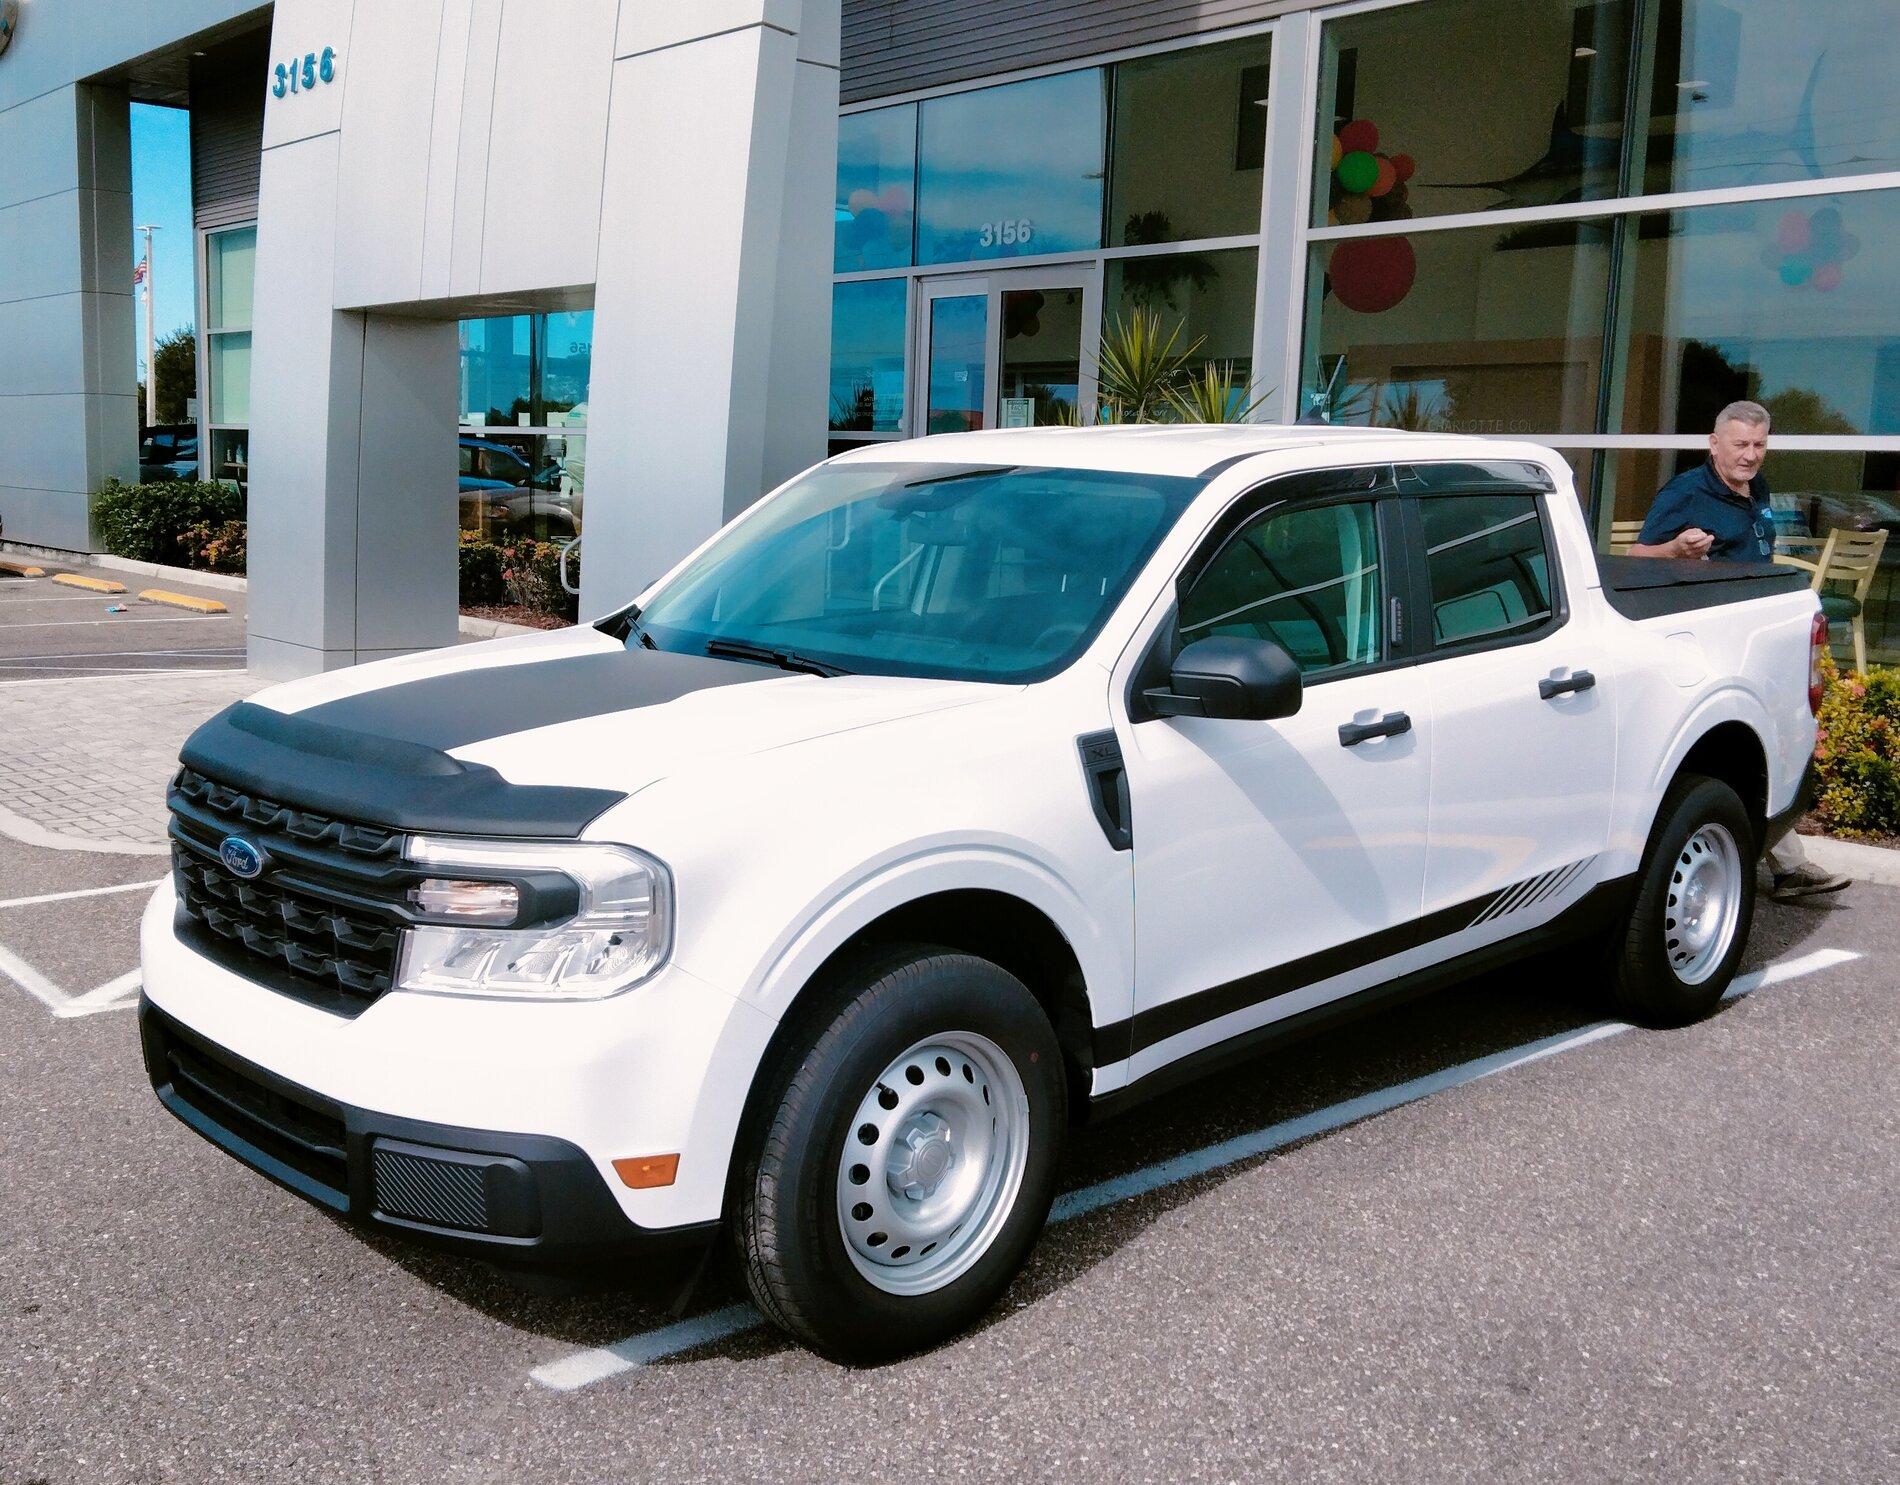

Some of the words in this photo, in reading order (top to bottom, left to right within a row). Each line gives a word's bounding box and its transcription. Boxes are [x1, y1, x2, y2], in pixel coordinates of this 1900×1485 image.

[272, 46, 335, 99] 3156
[979, 218, 1031, 248] 3156
[225, 844, 250, 871] Ford
